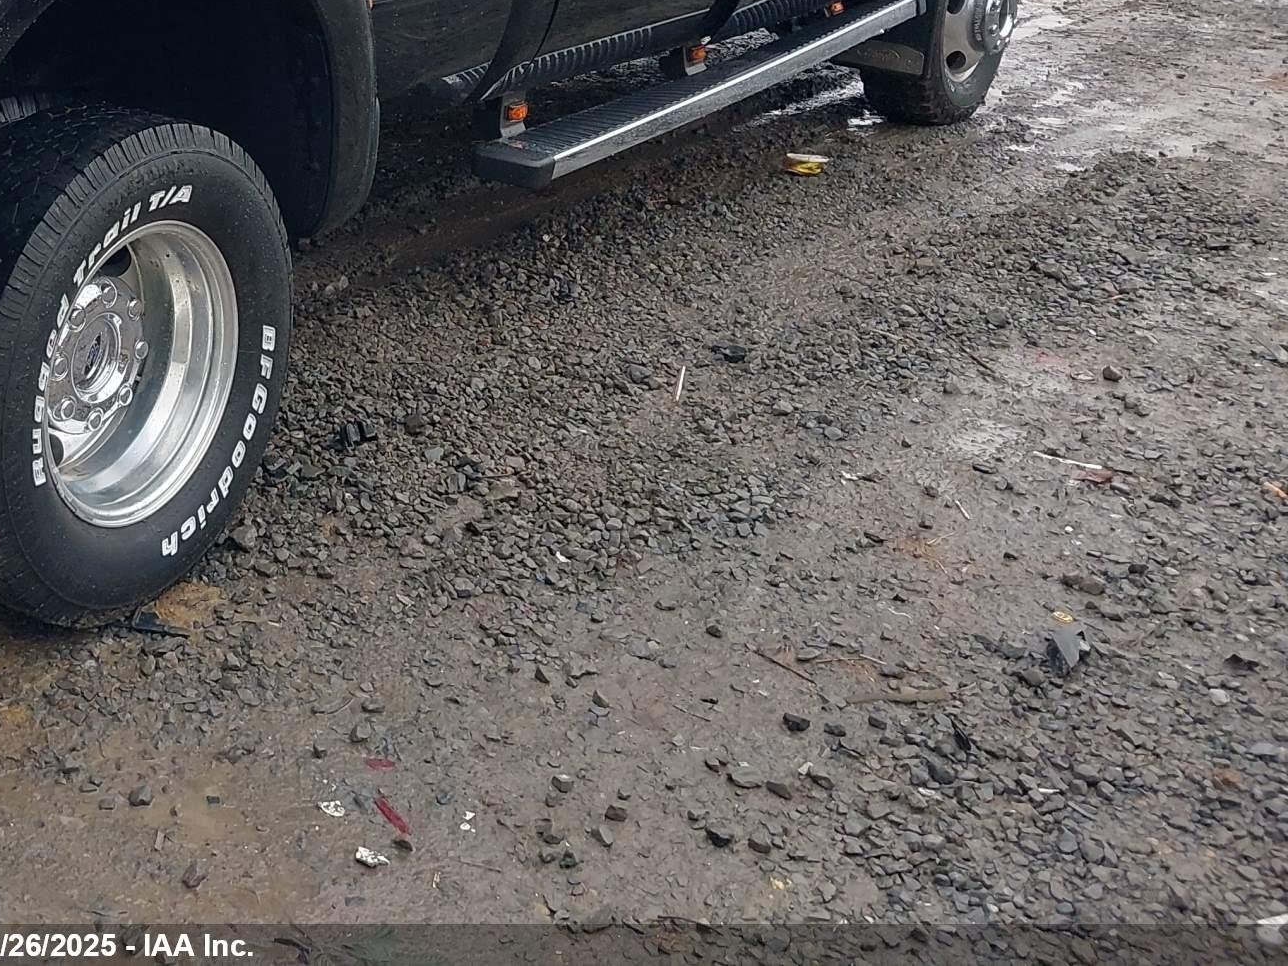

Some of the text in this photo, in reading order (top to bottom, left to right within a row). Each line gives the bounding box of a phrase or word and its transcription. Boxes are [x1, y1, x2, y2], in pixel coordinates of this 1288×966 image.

[31, 292, 70, 487] Rugged
[73, 201, 142, 287] Trail
[148, 184, 193, 212] T/A
[161, 324, 276, 557] BFGoodrich
